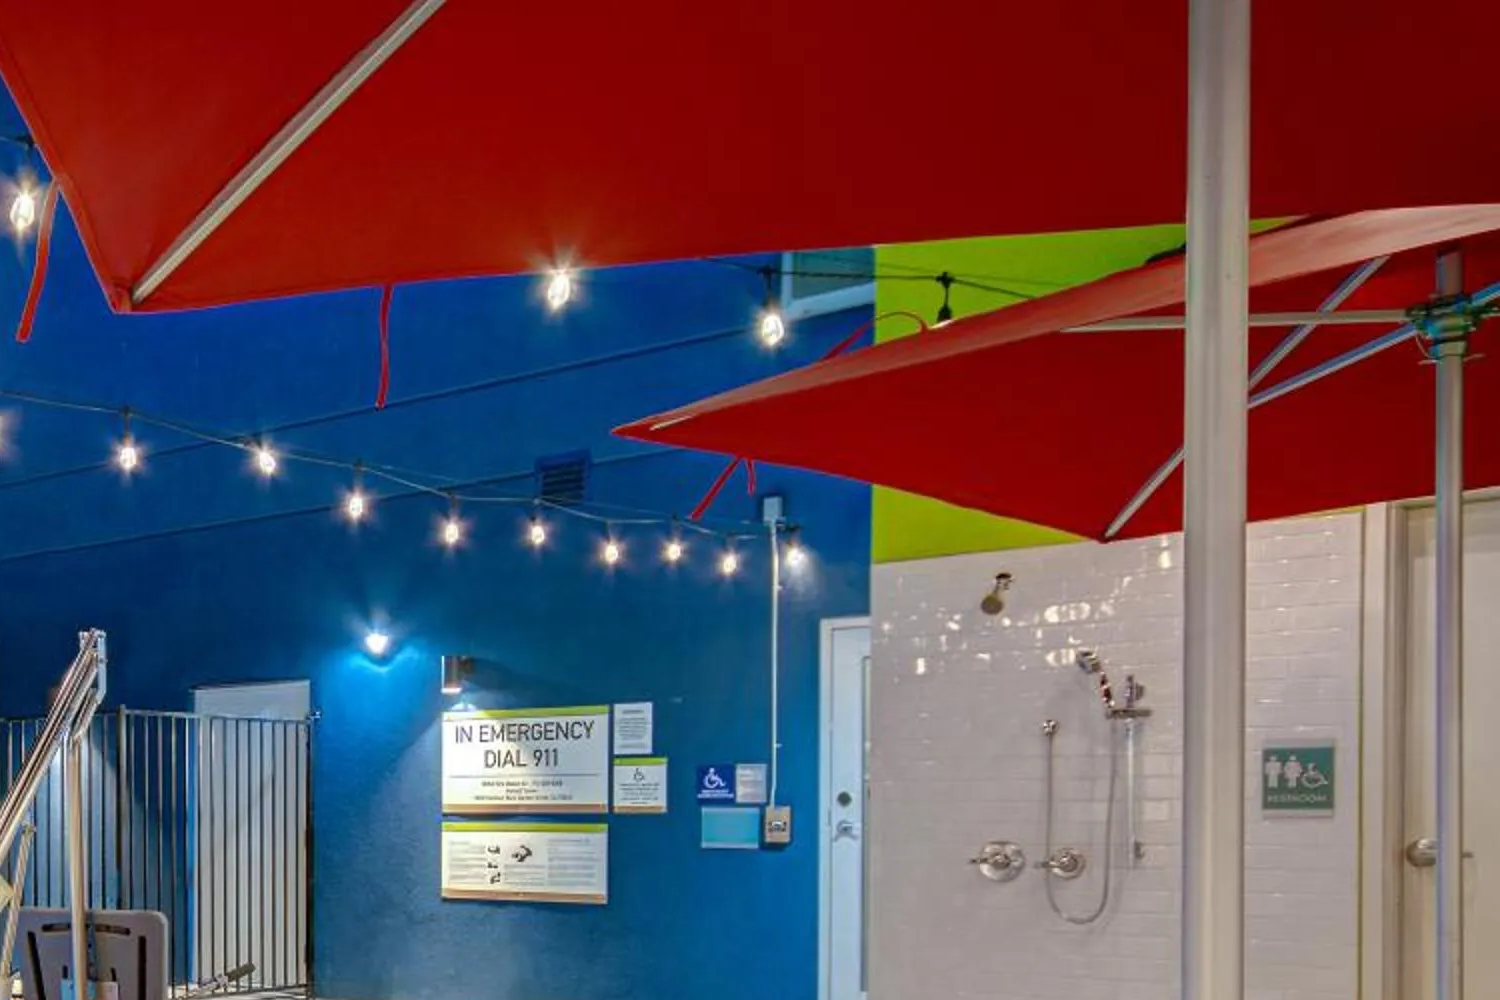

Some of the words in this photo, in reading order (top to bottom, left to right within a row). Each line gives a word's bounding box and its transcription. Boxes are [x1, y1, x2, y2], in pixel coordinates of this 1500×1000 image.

[455, 725, 473, 743] IN
[479, 720, 595, 743] EMERGENCY
[484, 749, 527, 768] DIAL
[533, 749, 559, 767] 911
